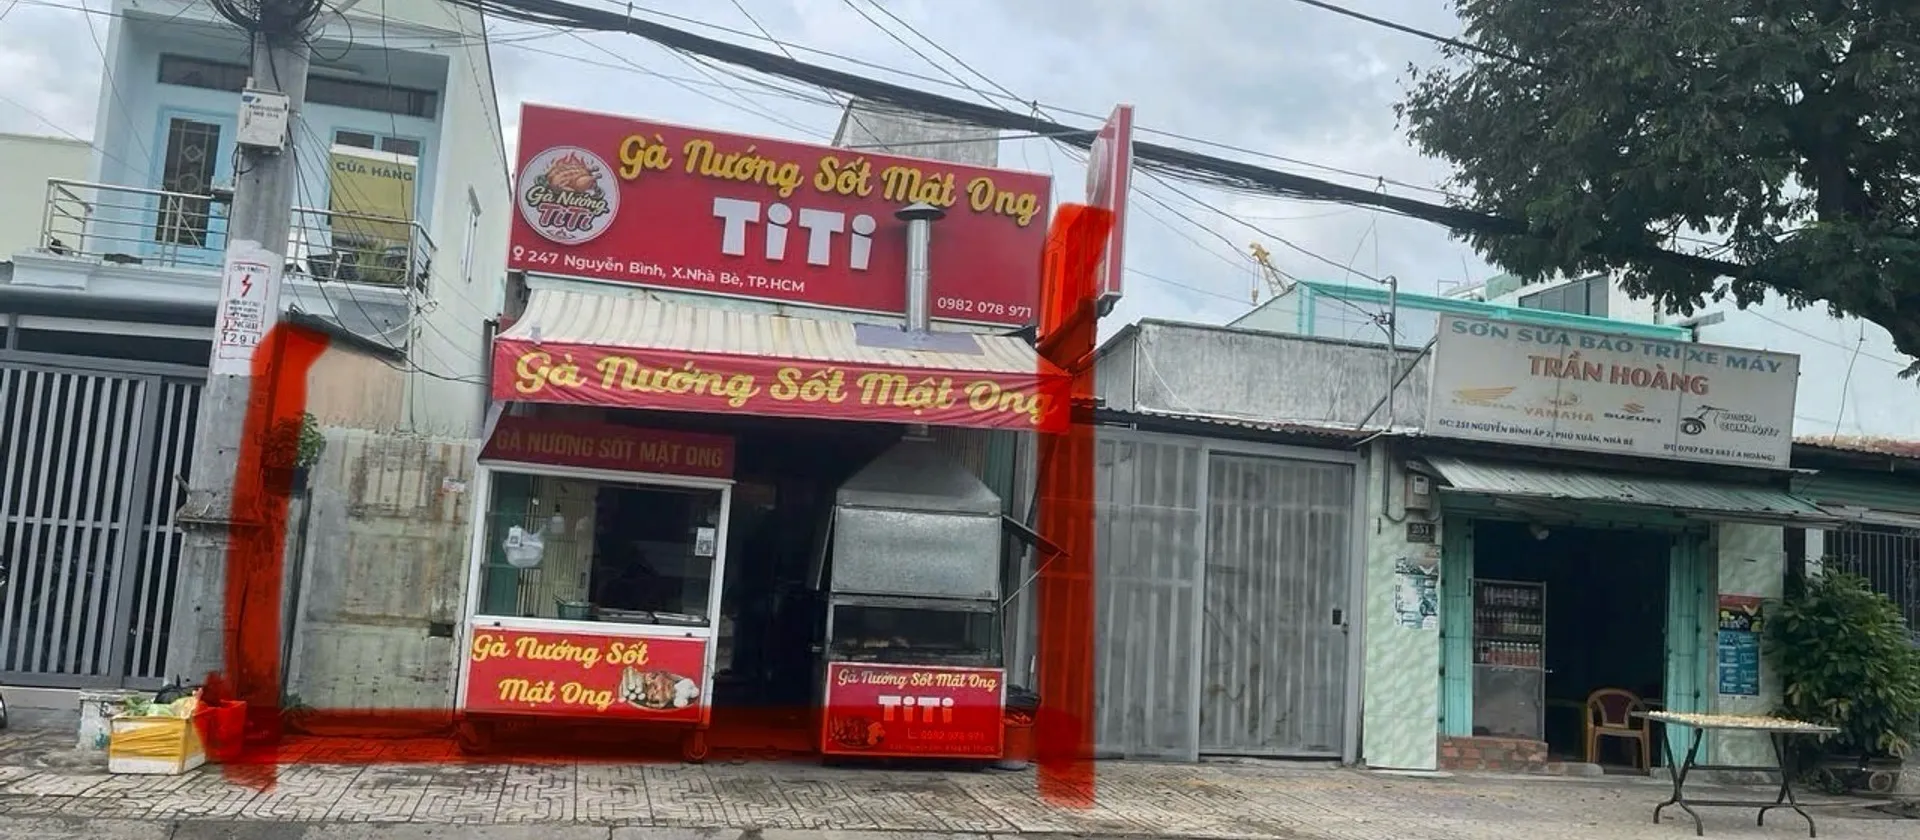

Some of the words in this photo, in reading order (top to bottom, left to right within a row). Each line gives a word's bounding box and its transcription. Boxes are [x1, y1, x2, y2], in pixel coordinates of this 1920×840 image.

[619, 134, 672, 180] Gà
[683, 139, 804, 198] Nướng
[813, 156, 873, 197] Sốt
[967, 176, 1041, 227] Ong
[526, 186, 554, 206] Gà
[556, 191, 609, 216] Nướng
[713, 197, 877, 270] TiTi
[528, 250, 559, 265] 247
[564, 253, 623, 273] Nguyễn
[629, 261, 667, 278] Bình,
[672, 266, 714, 282] X.Nhà
[720, 271, 743, 288] Bè,
[748, 275, 805, 293] TP.HCM
[937, 297, 973, 312] 0982
[978, 302, 1004, 315] 078
[1008, 305, 1032, 319] 971
[1451, 320, 1509, 340] SƠN
[1687, 348, 1718, 365] XE
[1726, 353, 1783, 373] MÁY
[515, 351, 587, 394] Gà
[597, 355, 760, 408] Nướng
[770, 366, 848, 403] Sốt
[856, 372, 956, 416] Mật
[965, 380, 1058, 425] Ong
[1528, 350, 1603, 383] TRẦN
[1610, 362, 1710, 396] HOÀNG
[1524, 407, 1594, 422] YAMAHA
[1604, 412, 1662, 424] SUZUKI
[496, 427, 521, 452] GÀ
[527, 431, 595, 458] NƯỚNG
[598, 434, 637, 463] SỐT
[639, 440, 682, 468] MẬT
[685, 445, 723, 468] ONG
[472, 634, 510, 662] Gà
[515, 636, 602, 669] Nướng
[606, 639, 649, 665] Sốt
[498, 677, 556, 708] Mật
[561, 681, 616, 712] Ong
[838, 668, 859, 686] Gà
[861, 670, 909, 690] Nướng
[910, 671, 934, 688] Sốt
[936, 673, 966, 692] Mật
[968, 673, 998, 693] Ong
[878, 695, 954, 723] TiTi
